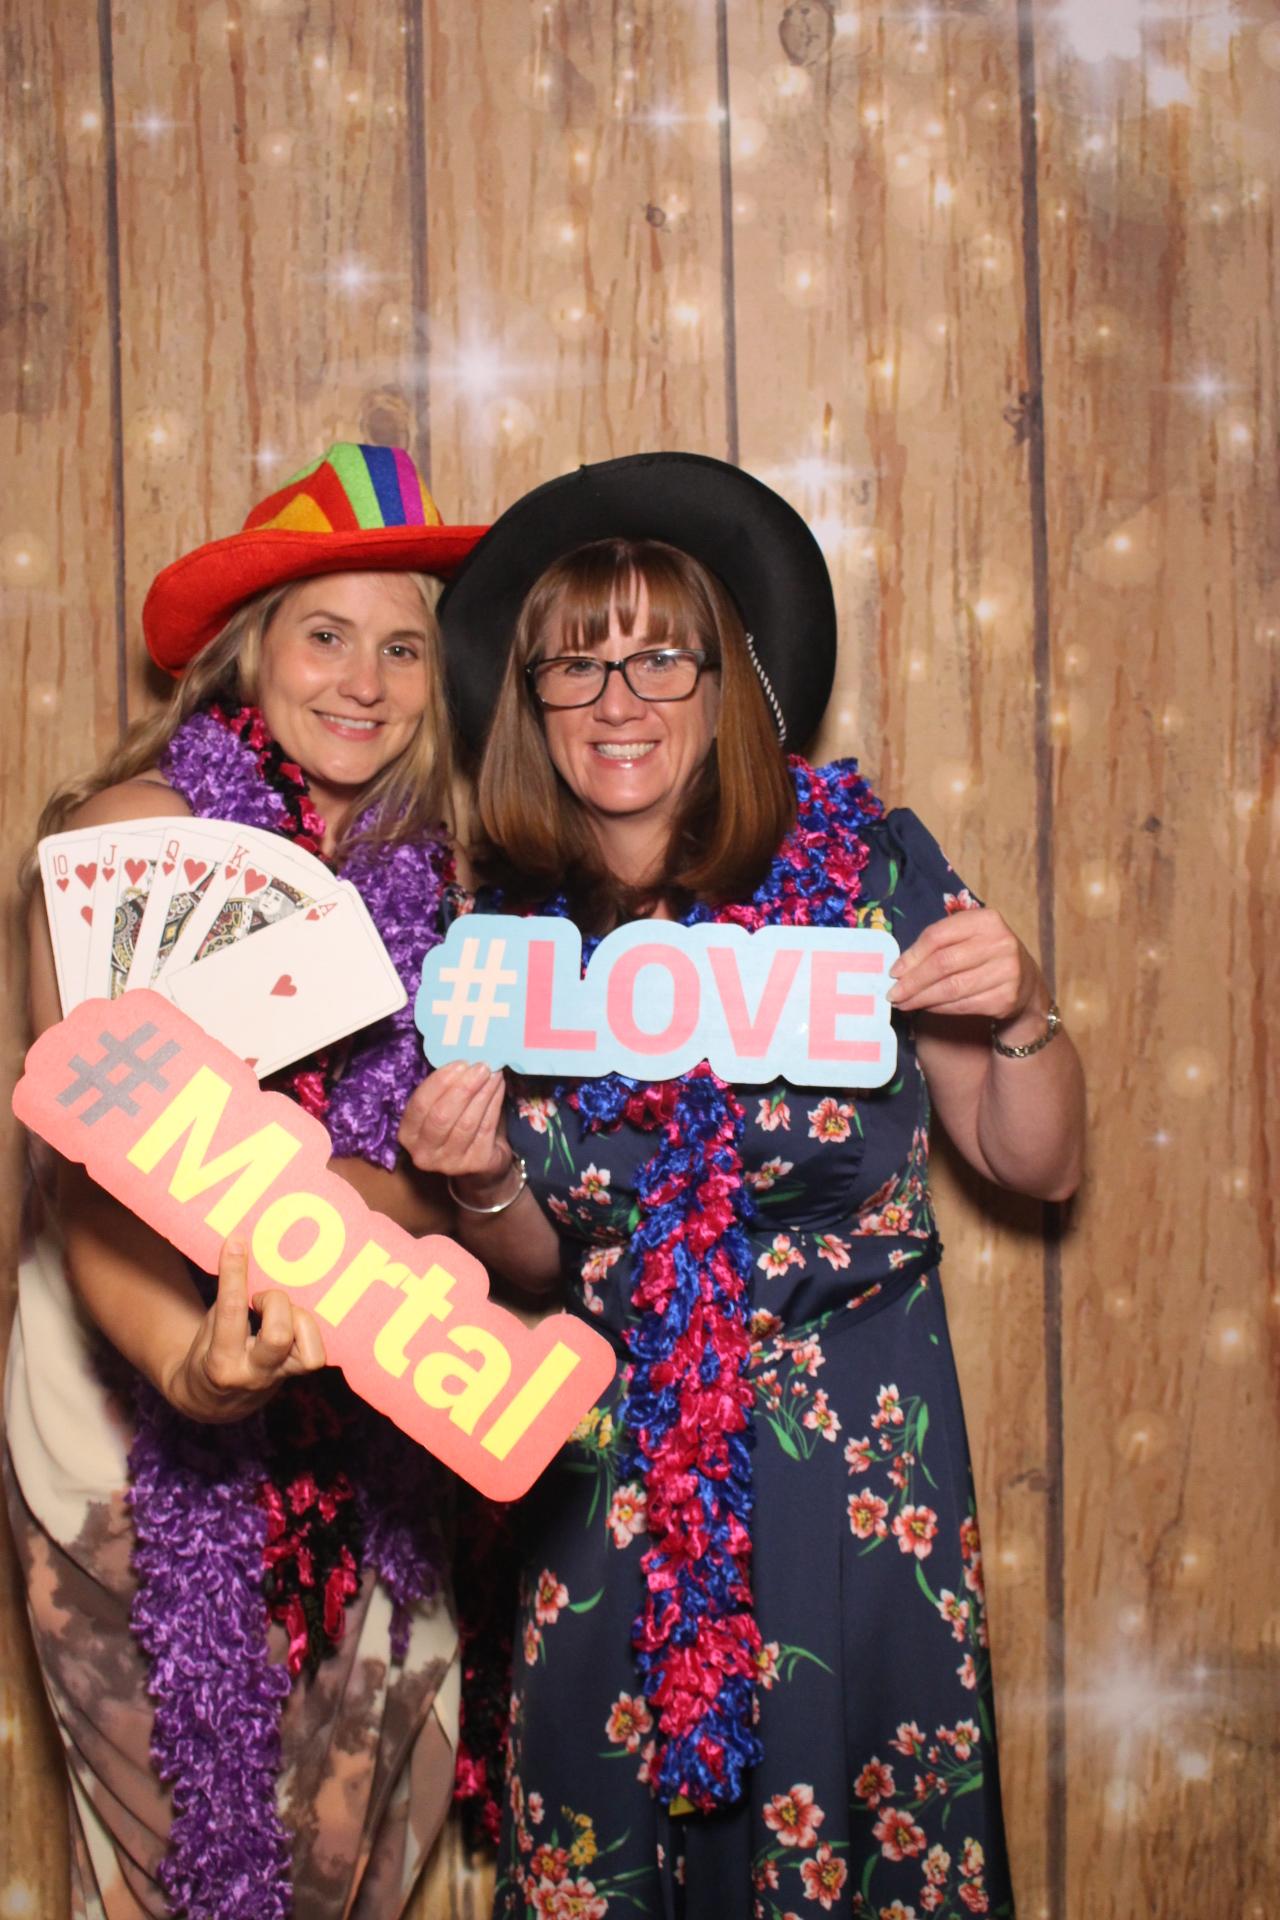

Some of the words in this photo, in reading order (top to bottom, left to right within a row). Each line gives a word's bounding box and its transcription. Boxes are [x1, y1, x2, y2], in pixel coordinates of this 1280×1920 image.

[103, 845, 118, 866] J
[165, 840, 181, 862] Q
[229, 846, 251, 869] K
[53, 854, 69, 876] 10
[319, 902, 338, 918] A
[432, 937, 885, 1063] #LOVE
[56, 1021, 581, 1461] #Mortal
